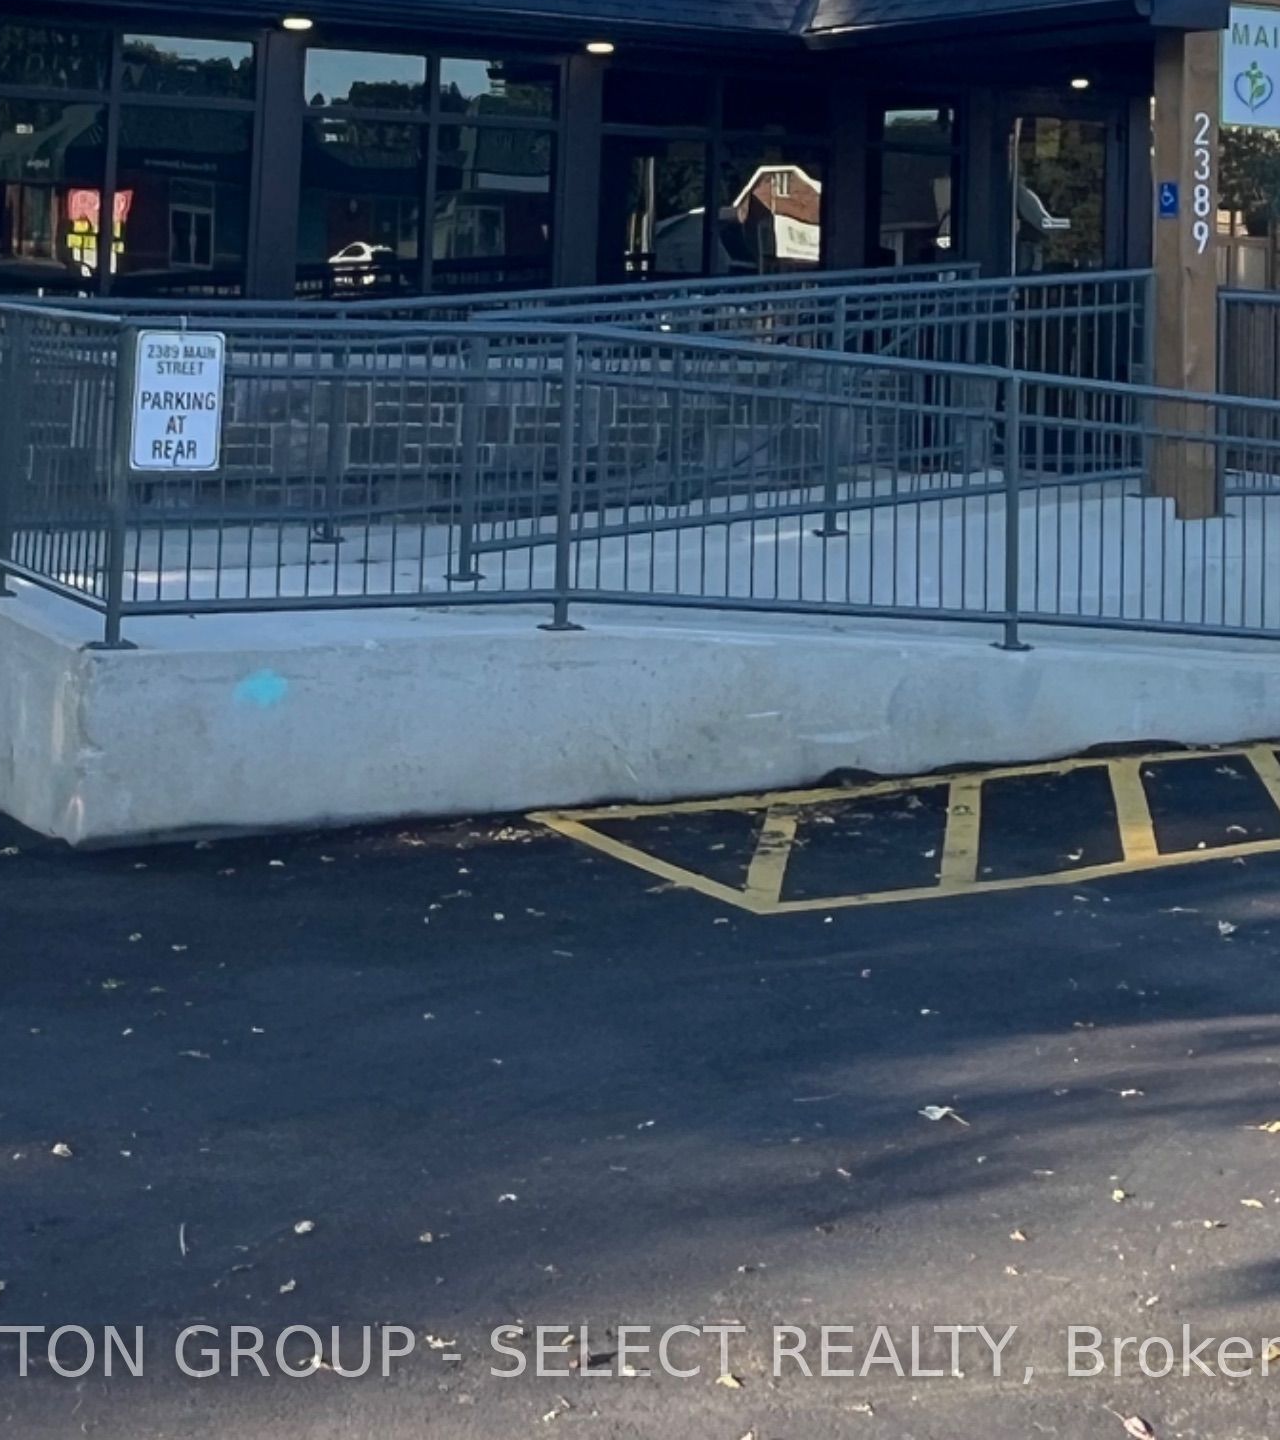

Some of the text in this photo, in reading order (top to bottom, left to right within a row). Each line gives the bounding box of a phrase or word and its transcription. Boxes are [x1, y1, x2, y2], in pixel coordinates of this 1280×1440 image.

[1193, 112, 1211, 255] 2389
[183, 344, 217, 360] MAIN
[156, 361, 205, 375] STREET
[140, 391, 216, 410] PARKING
[165, 415, 188, 435] AT
[152, 440, 197, 459] REAR
